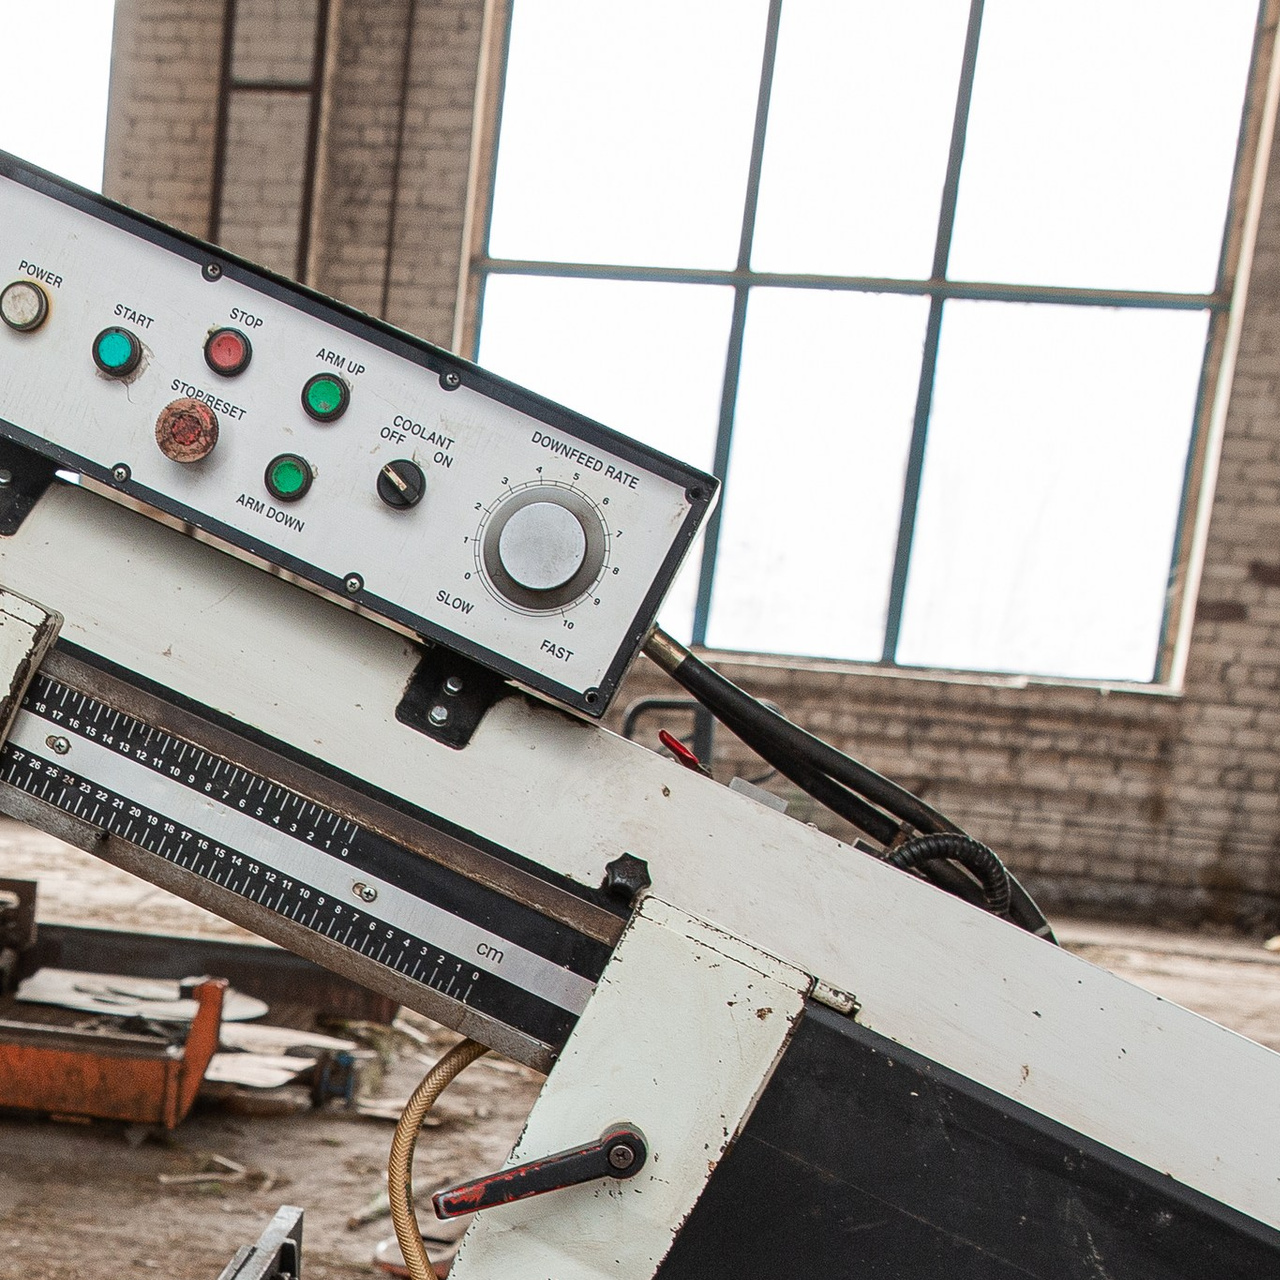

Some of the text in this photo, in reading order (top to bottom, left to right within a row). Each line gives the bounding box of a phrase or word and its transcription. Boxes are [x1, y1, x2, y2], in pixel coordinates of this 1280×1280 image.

[18, 259, 63, 288] POWER
[114, 304, 154, 329] START
[230, 308, 263, 329] STOP
[316, 348, 366, 376] ARM UP
[170, 378, 247, 421] STOP/RESET
[392, 416, 454, 450] COOLANT
[380, 427, 453, 468] OFF ON
[531, 431, 639, 489] DOWNFEED RATE
[501, 477, 509, 485] 3
[573, 472, 580, 480] 5
[474, 502, 482, 510] 2
[603, 497, 610, 505] 6
[236, 494, 305, 532] ARM DOWN
[616, 530, 623, 538] 7
[464, 572, 471, 580] 0
[612, 567, 620, 575] 8
[436, 590, 474, 614] SLOW
[593, 598, 601, 606] 9
[563, 620, 574, 630] 10
[540, 639, 574, 662] FAST
[36, 702, 348, 856] 18 17 16 15 14 13 12 11 10 9 8 7 6 5 4 3 2 1 0
[12, 751, 479, 980] 27 26 25 24 23 22 21 20 19 18 17 16 15 14 13 12 11 10 9 8 7 6 5 4 3 2 1 0
[476, 943, 504, 964] cm
